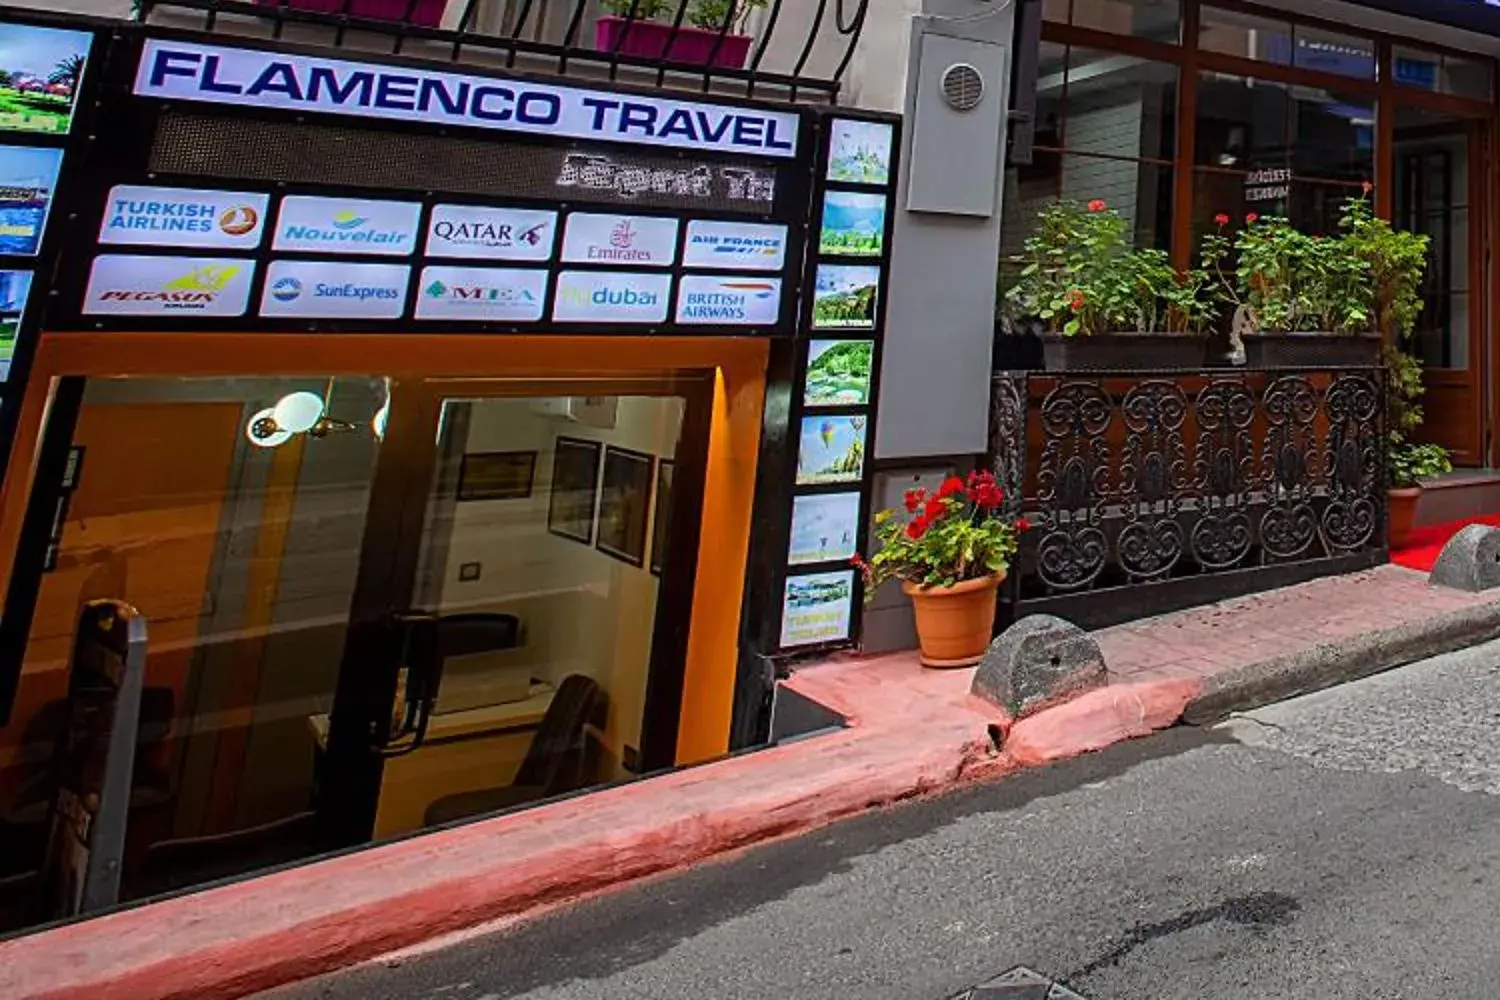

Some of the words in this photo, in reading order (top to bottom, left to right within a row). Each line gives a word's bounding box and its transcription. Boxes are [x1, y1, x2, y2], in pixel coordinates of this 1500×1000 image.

[148, 50, 562, 125] FLAMENCO
[582, 97, 793, 150] TRAVEL
[114, 199, 216, 218] TURKISH
[109, 215, 212, 232] AIRLINES
[434, 221, 512, 241] QATAR
[285, 226, 408, 244] Nouvelair
[691, 235, 720, 246] AIR
[722, 237, 781, 248] FRANCE
[588, 247, 652, 262] Emirates
[314, 283, 399, 300] SunExpress
[687, 293, 745, 305] BRITISH
[683, 305, 745, 318] AIRWAYS
